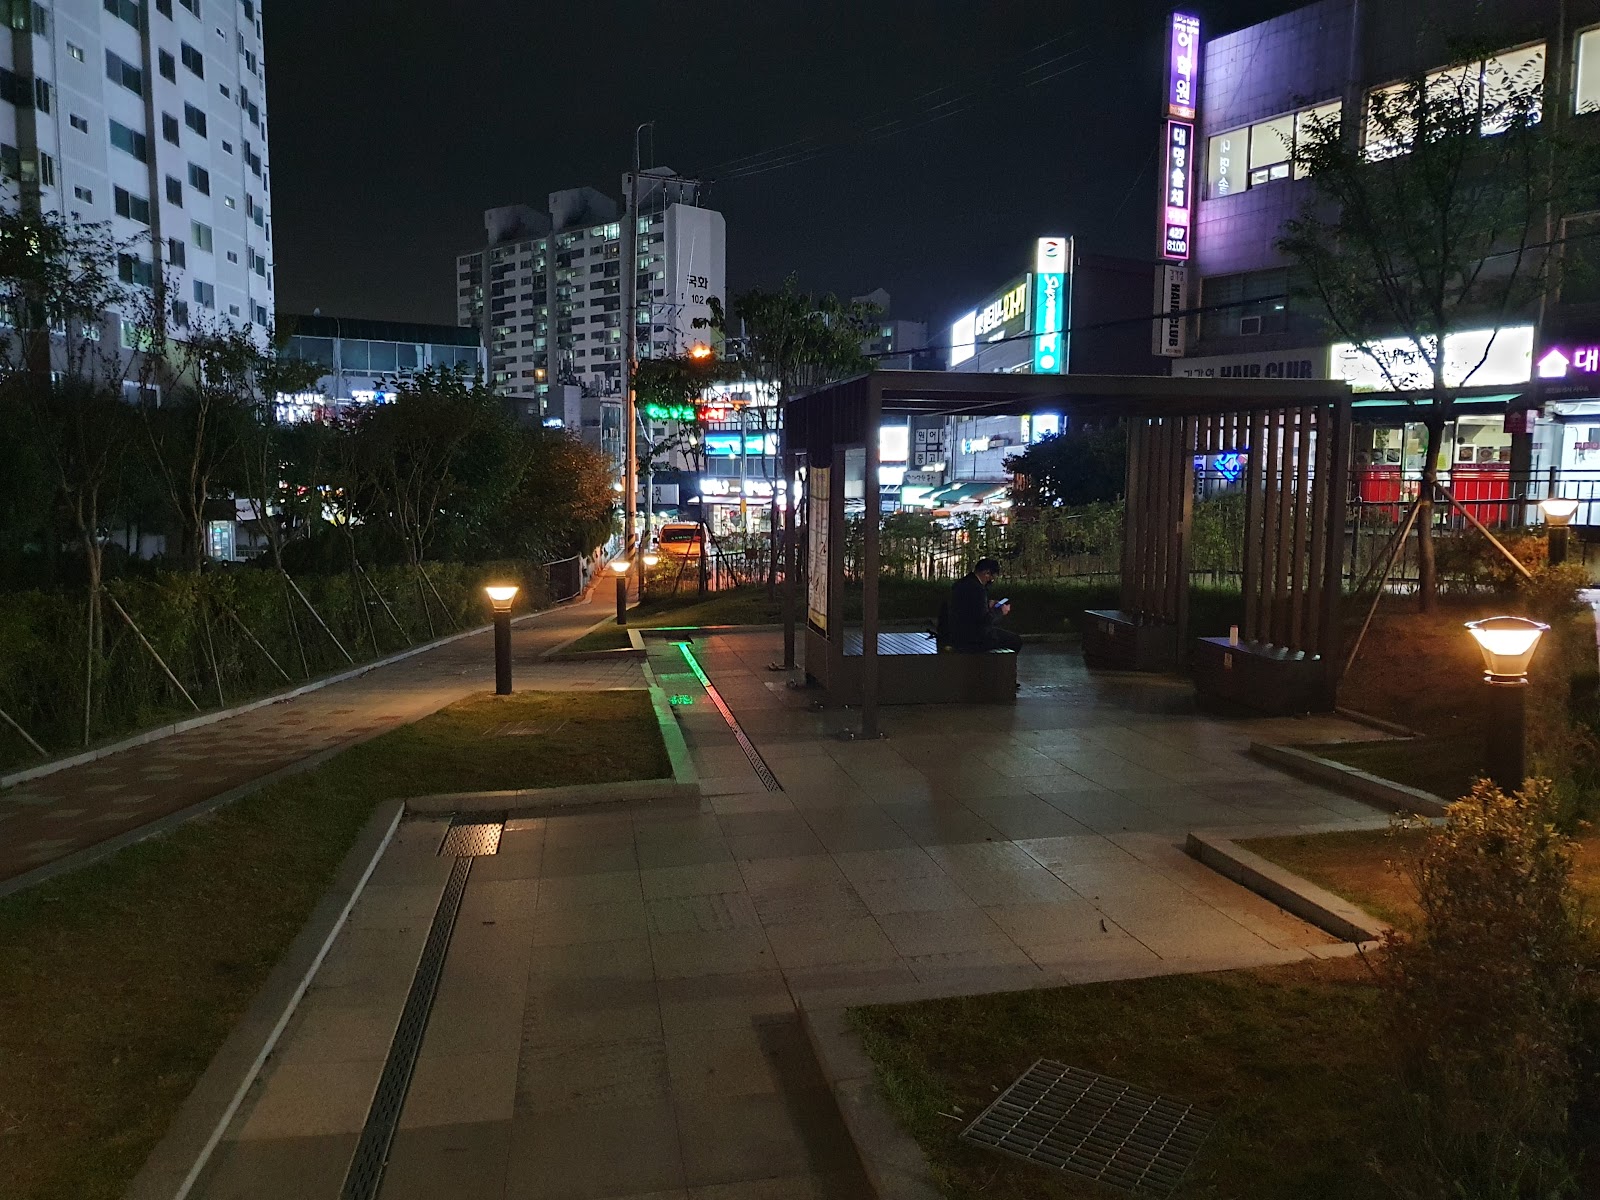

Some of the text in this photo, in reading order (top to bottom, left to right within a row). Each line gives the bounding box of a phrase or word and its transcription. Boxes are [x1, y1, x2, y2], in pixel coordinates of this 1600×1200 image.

[1167, 240, 1187, 253] 8100
[687, 274, 709, 289] 국화
[691, 294, 704, 305] 102
[1170, 283, 1181, 312] HAIR
[1168, 317, 1178, 347] CLUB
[917, 453, 944, 464] 중고
